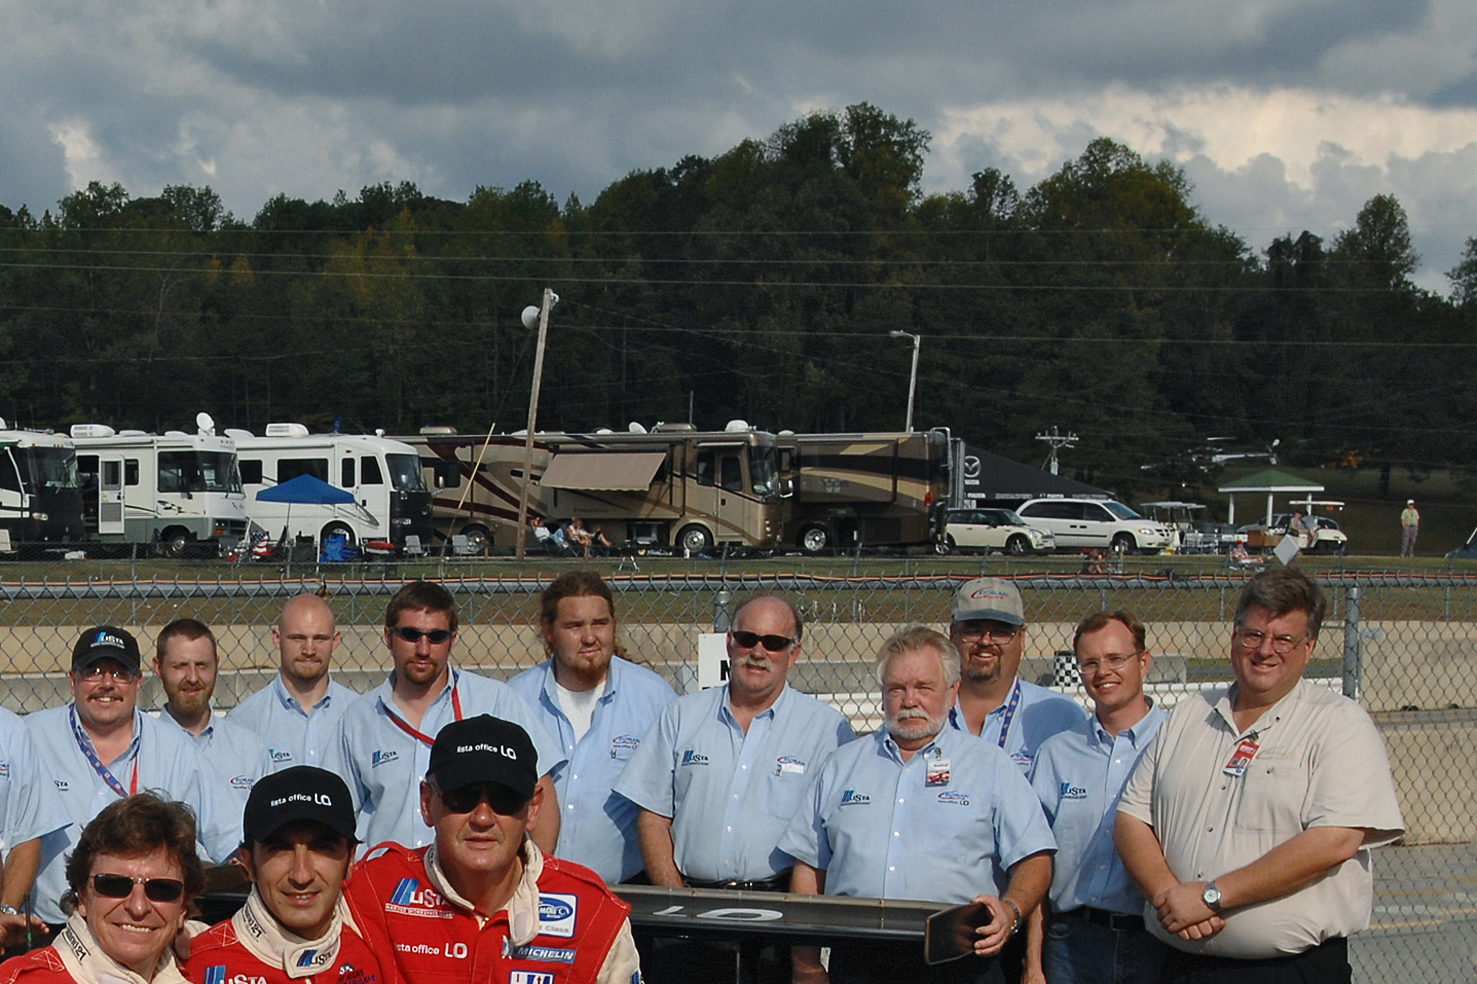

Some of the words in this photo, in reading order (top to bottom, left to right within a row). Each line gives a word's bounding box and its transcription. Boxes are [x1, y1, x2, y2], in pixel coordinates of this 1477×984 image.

[456, 745, 473, 753] lista
[475, 742, 498, 753] office
[270, 797, 287, 806] lista
[288, 792, 312, 802] office
[412, 944, 440, 955] office
[444, 942, 468, 958] LO
[518, 947, 574, 960] MICHELIN
